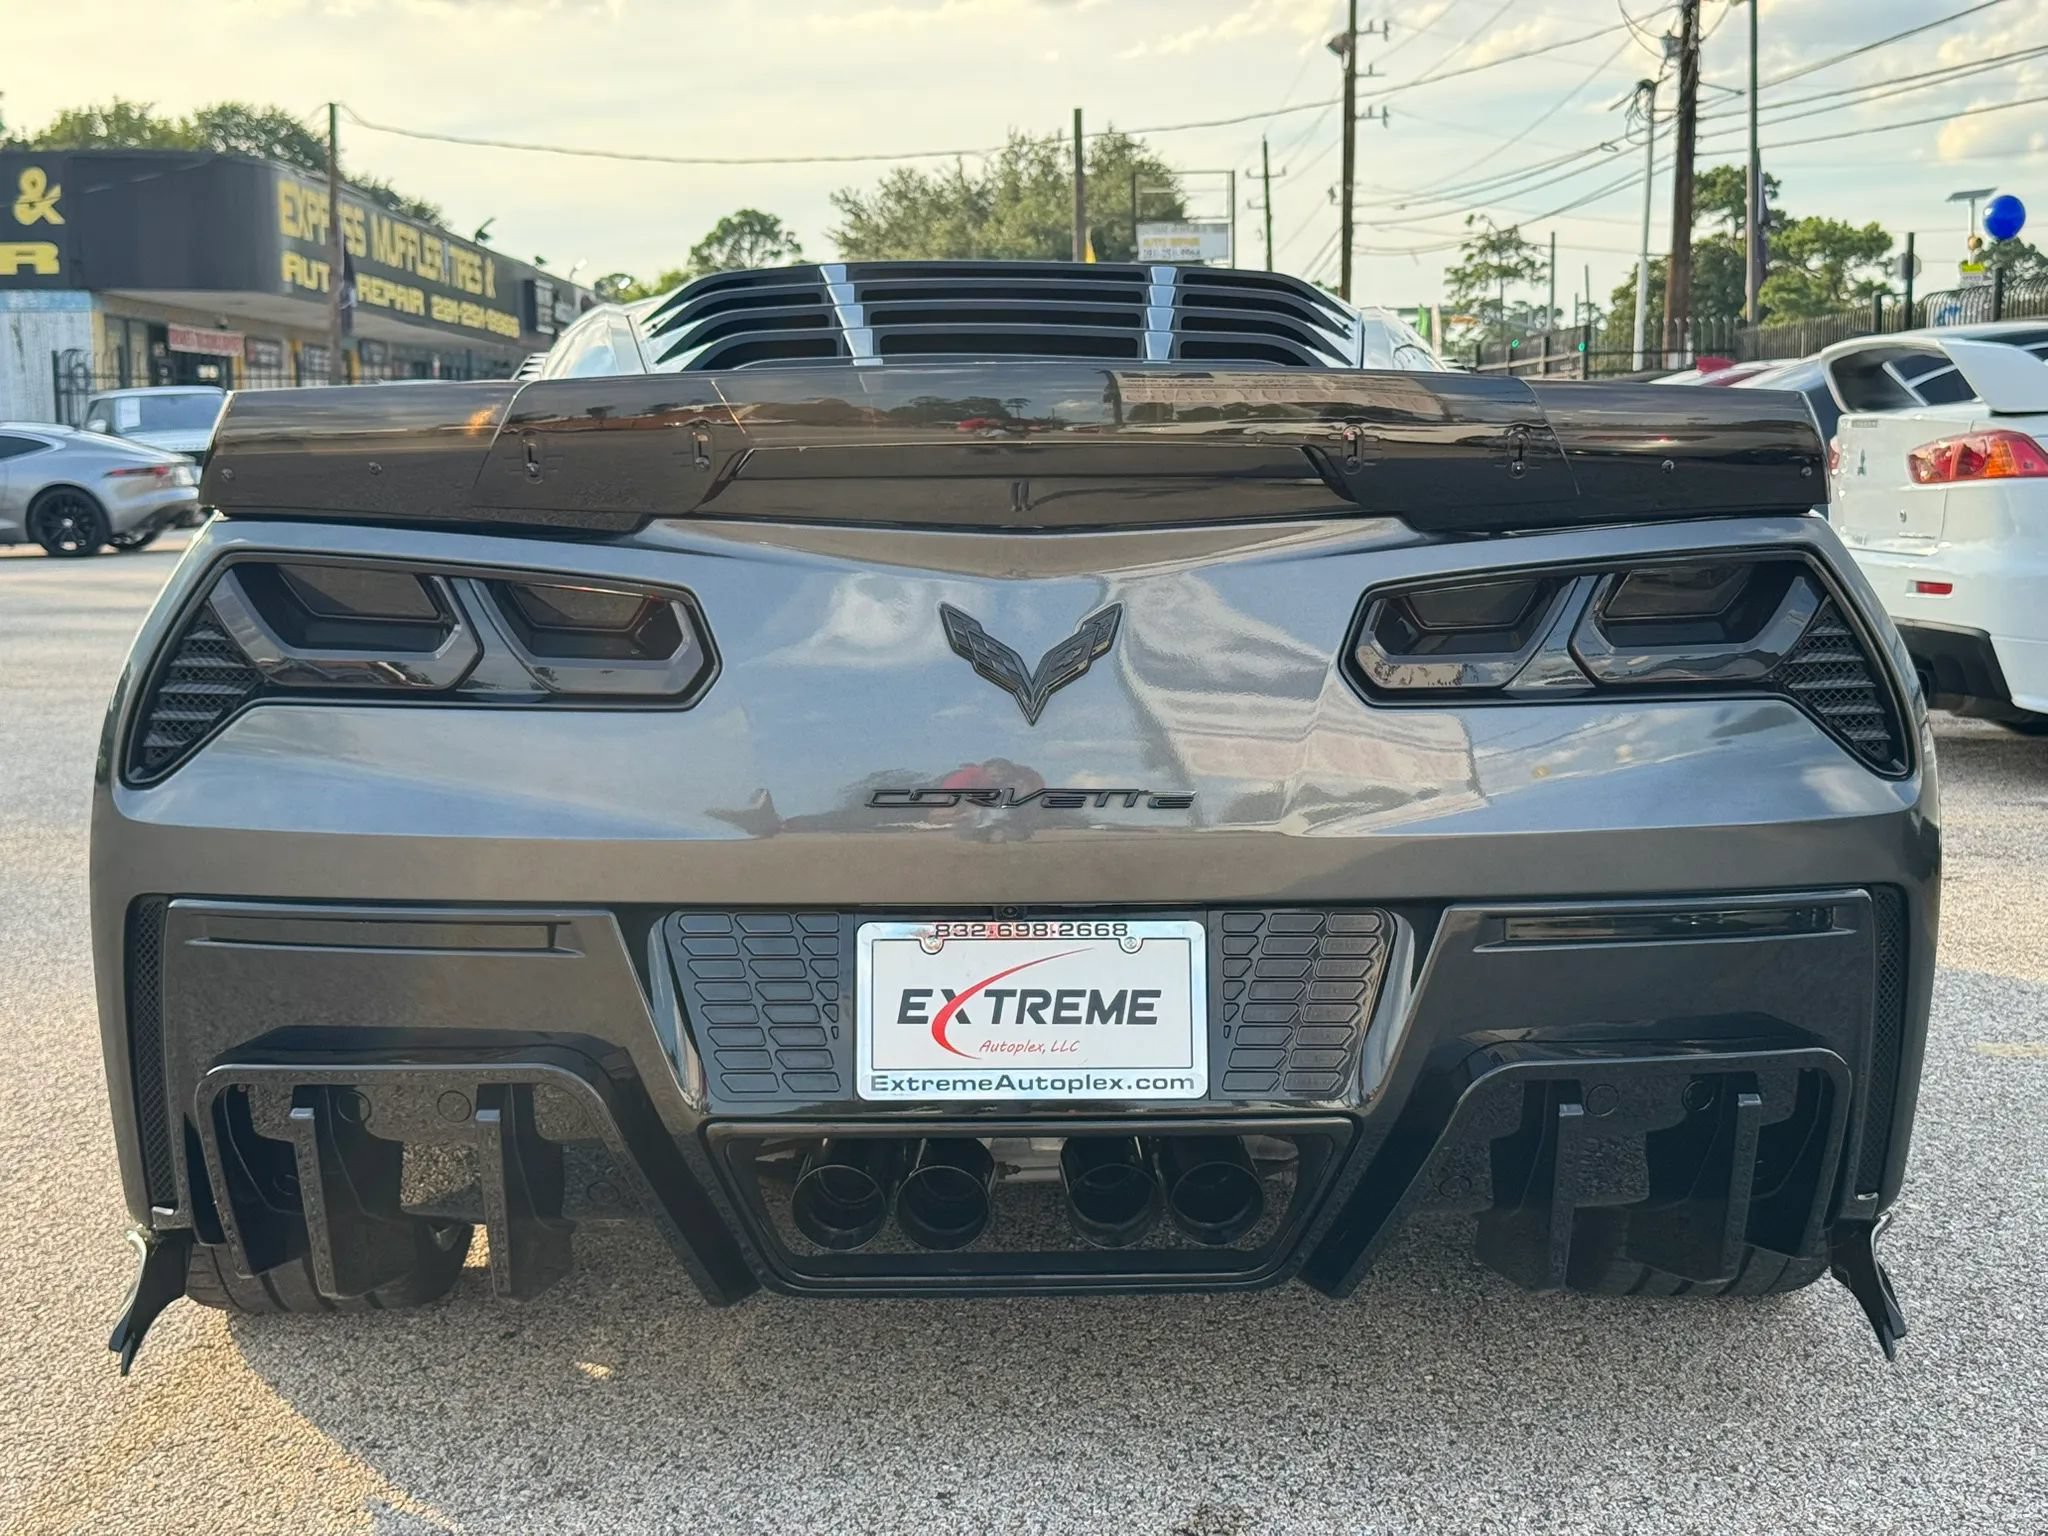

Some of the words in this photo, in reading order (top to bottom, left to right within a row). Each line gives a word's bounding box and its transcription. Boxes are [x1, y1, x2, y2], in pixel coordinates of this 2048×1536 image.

[13, 166, 66, 226] &
[281, 249, 331, 294] AUT
[356, 271, 425, 317] REPAIR
[897, 988, 1162, 1025] EXTREME
[979, 1039, 1046, 1056] Autoplex,
[1050, 1040, 1081, 1053] LLC
[870, 1074, 1195, 1095] ExtremeAutoplex.com
